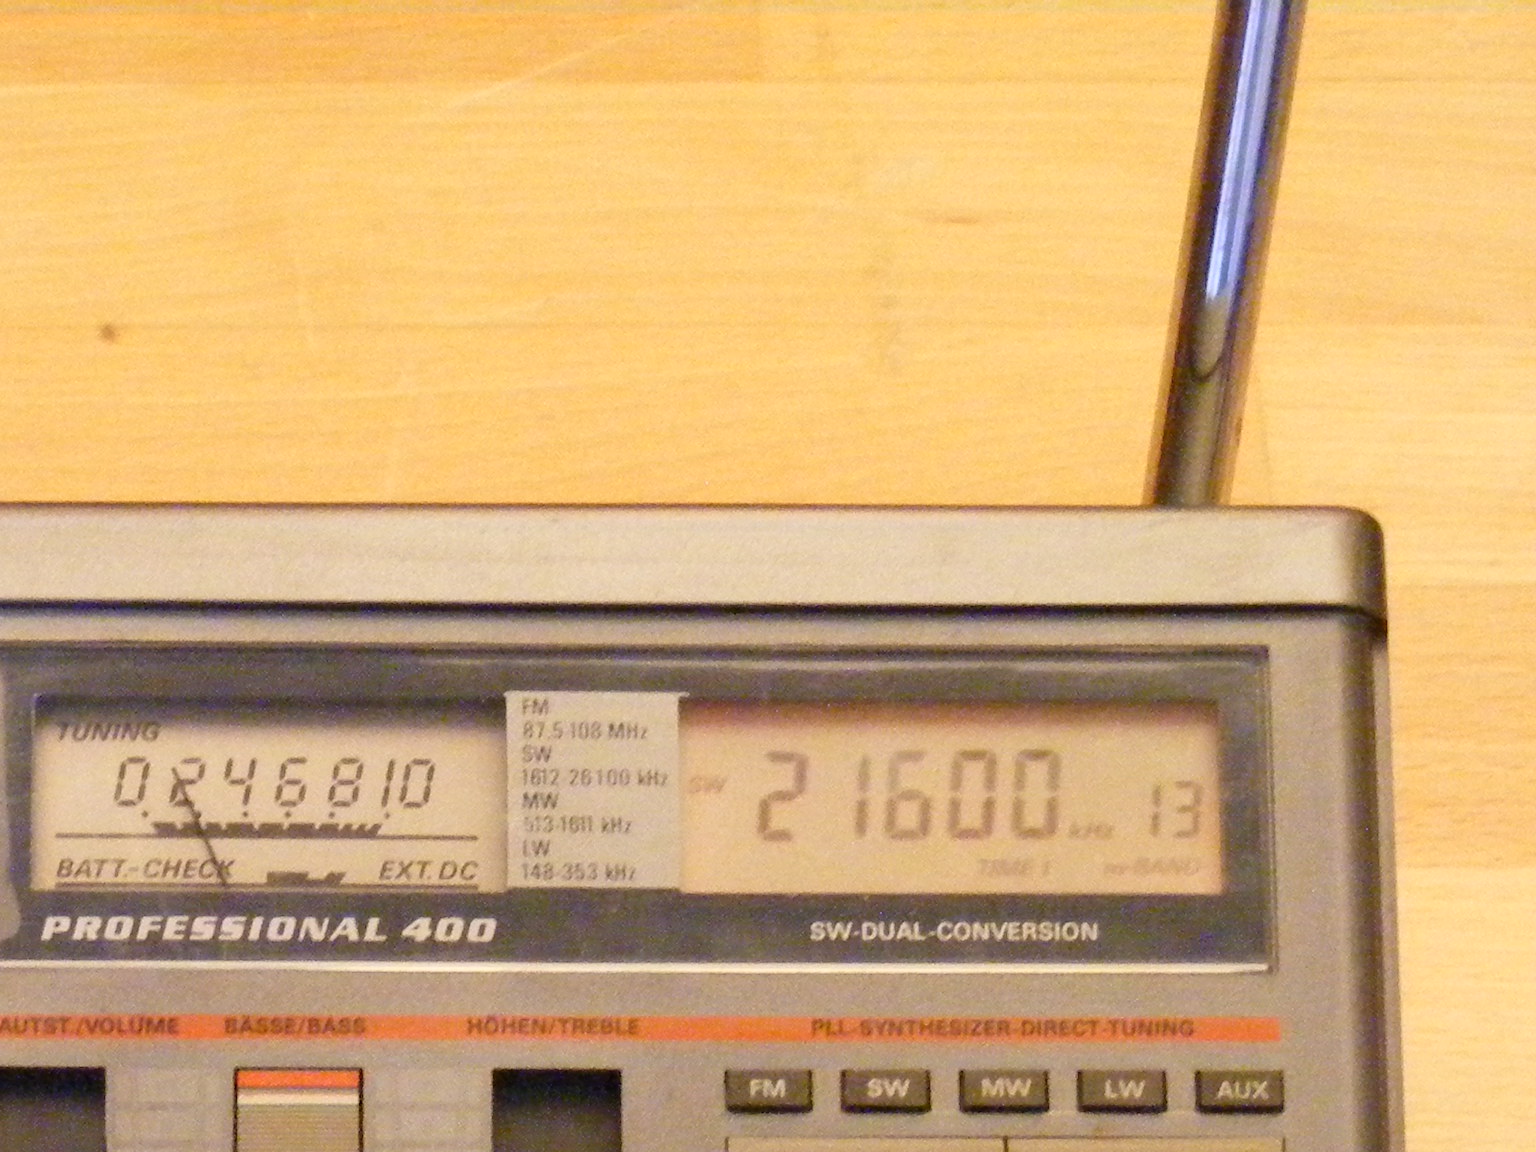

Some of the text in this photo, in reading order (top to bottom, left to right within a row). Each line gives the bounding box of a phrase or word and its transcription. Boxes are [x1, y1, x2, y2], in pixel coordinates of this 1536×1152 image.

[521, 698, 550, 716] FM
[55, 721, 162, 742] TUNING
[607, 722, 649, 740] MHz
[521, 743, 553, 763] SW
[637, 769, 669, 787] kHz
[521, 792, 560, 810] MW
[1148, 779, 1206, 840] 13
[599, 816, 634, 834] kHz
[521, 839, 552, 858] LW
[604, 863, 638, 882] kHz
[40, 914, 499, 944] PROFESSIONAL 400
[747, 1077, 787, 1099] FM
[865, 1077, 912, 1100] SW
[979, 1077, 1034, 1100] MW
[1103, 1078, 1147, 1100] LW
[1215, 1079, 1270, 1102] AUX
